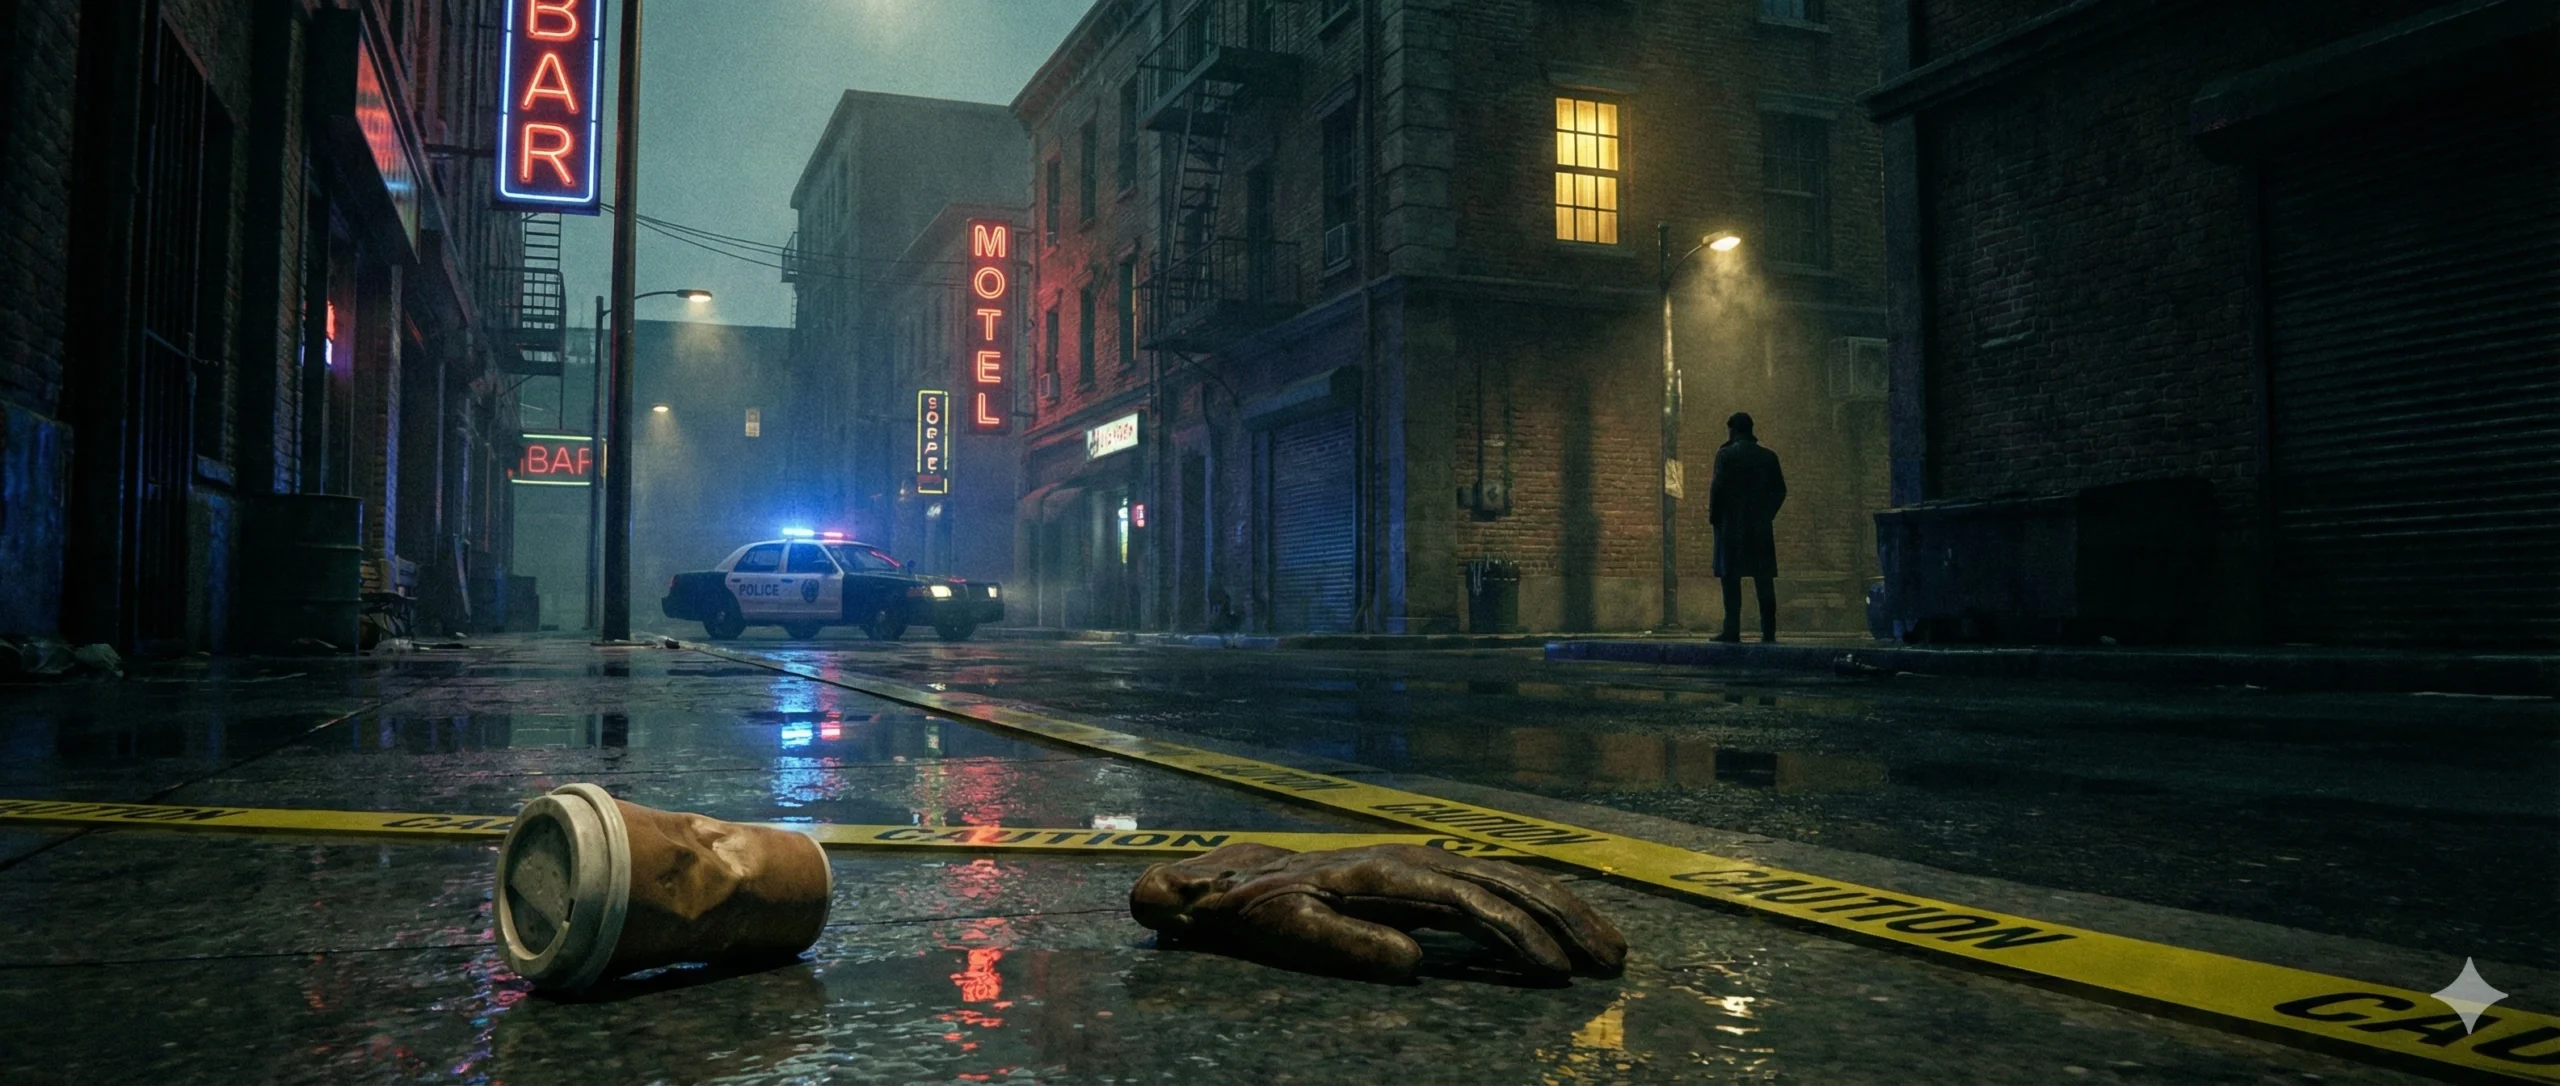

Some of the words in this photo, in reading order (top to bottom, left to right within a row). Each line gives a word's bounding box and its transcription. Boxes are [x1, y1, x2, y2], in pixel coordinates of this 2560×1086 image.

[521, 0, 579, 187] BAR
[974, 224, 1006, 424] MOTEL
[740, 584, 780, 597] POLICE
[0, 802, 249, 821] AUTION
[873, 828, 1231, 847] CAUTION
[1368, 803, 1610, 846] CAUTION
[1669, 869, 2079, 950] CAUTION
